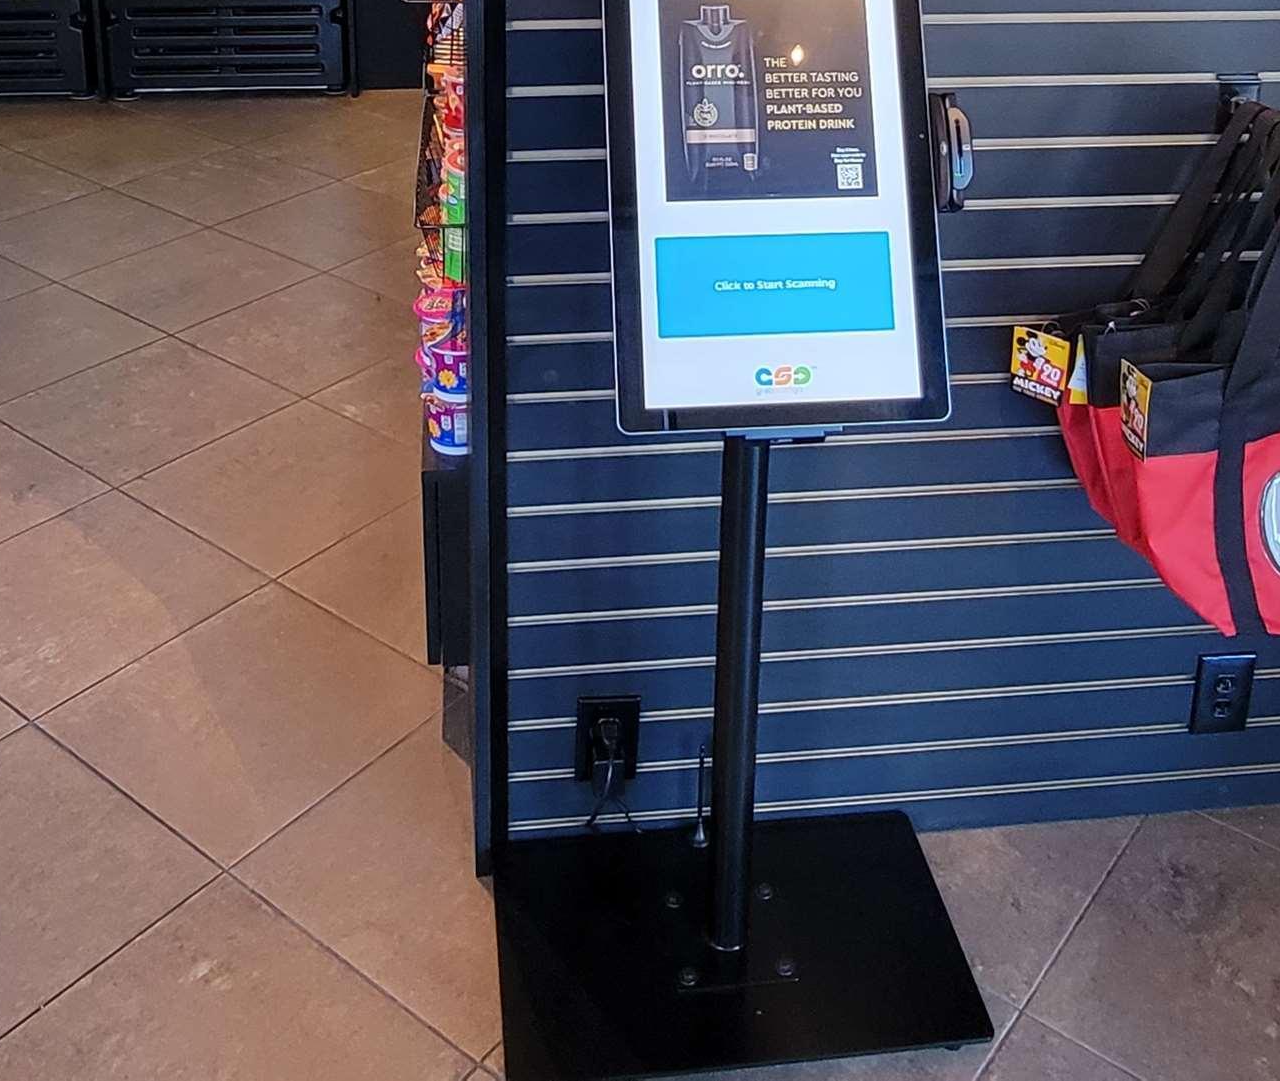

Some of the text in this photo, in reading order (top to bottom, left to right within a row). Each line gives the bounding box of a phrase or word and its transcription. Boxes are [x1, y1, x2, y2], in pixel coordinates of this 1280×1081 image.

[764, 57, 787, 68] THE
[765, 72, 859, 83] BETTER TASTING
[765, 87, 862, 99] BETTER FOR YOU
[766, 103, 843, 114] PLANT-BASED
[767, 118, 856, 130] PROTEIN DRINK
[714, 278, 837, 291] Click to Start Scanning
[1013, 376, 1061, 400] MICKEY
